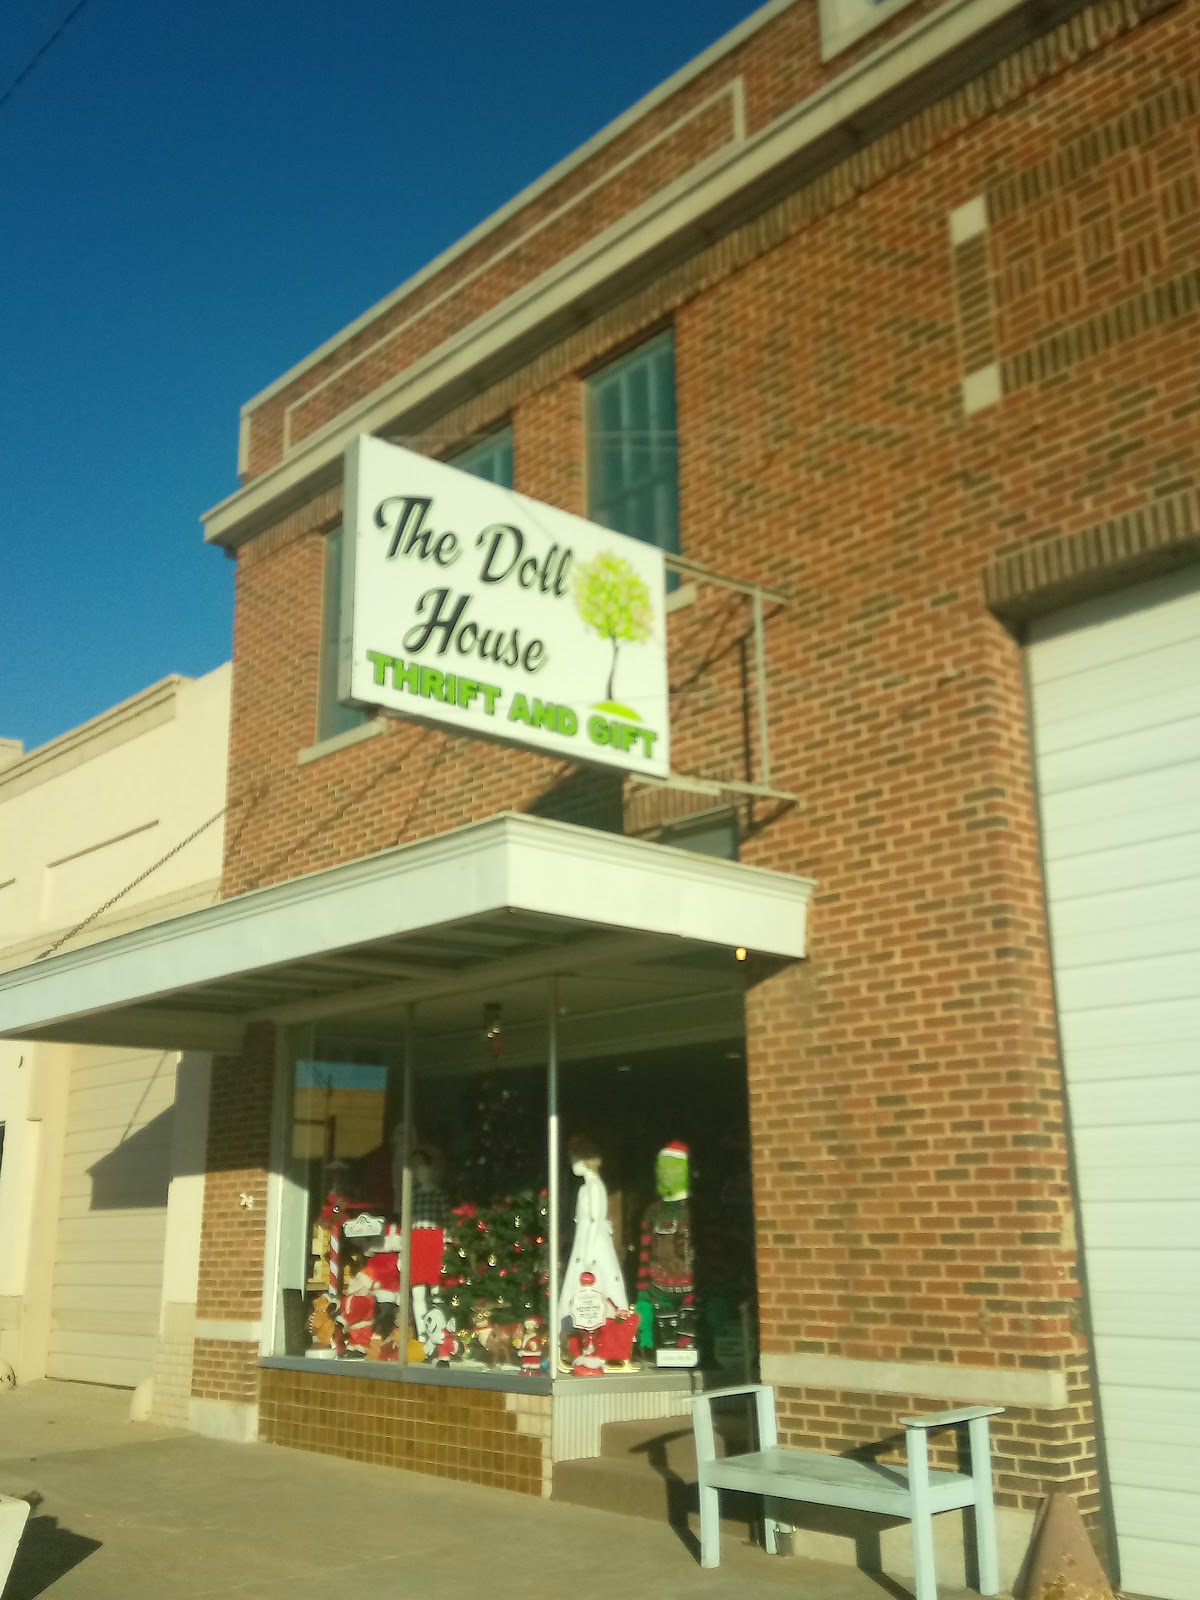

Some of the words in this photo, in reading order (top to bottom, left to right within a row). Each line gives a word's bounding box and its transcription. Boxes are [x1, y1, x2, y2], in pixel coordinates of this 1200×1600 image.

[373, 496, 461, 567] The
[475, 523, 573, 597] Doll
[402, 587, 546, 672] House
[367, 650, 502, 716] THRIFT
[508, 693, 579, 737] AND
[587, 714, 658, 759] GIFT
